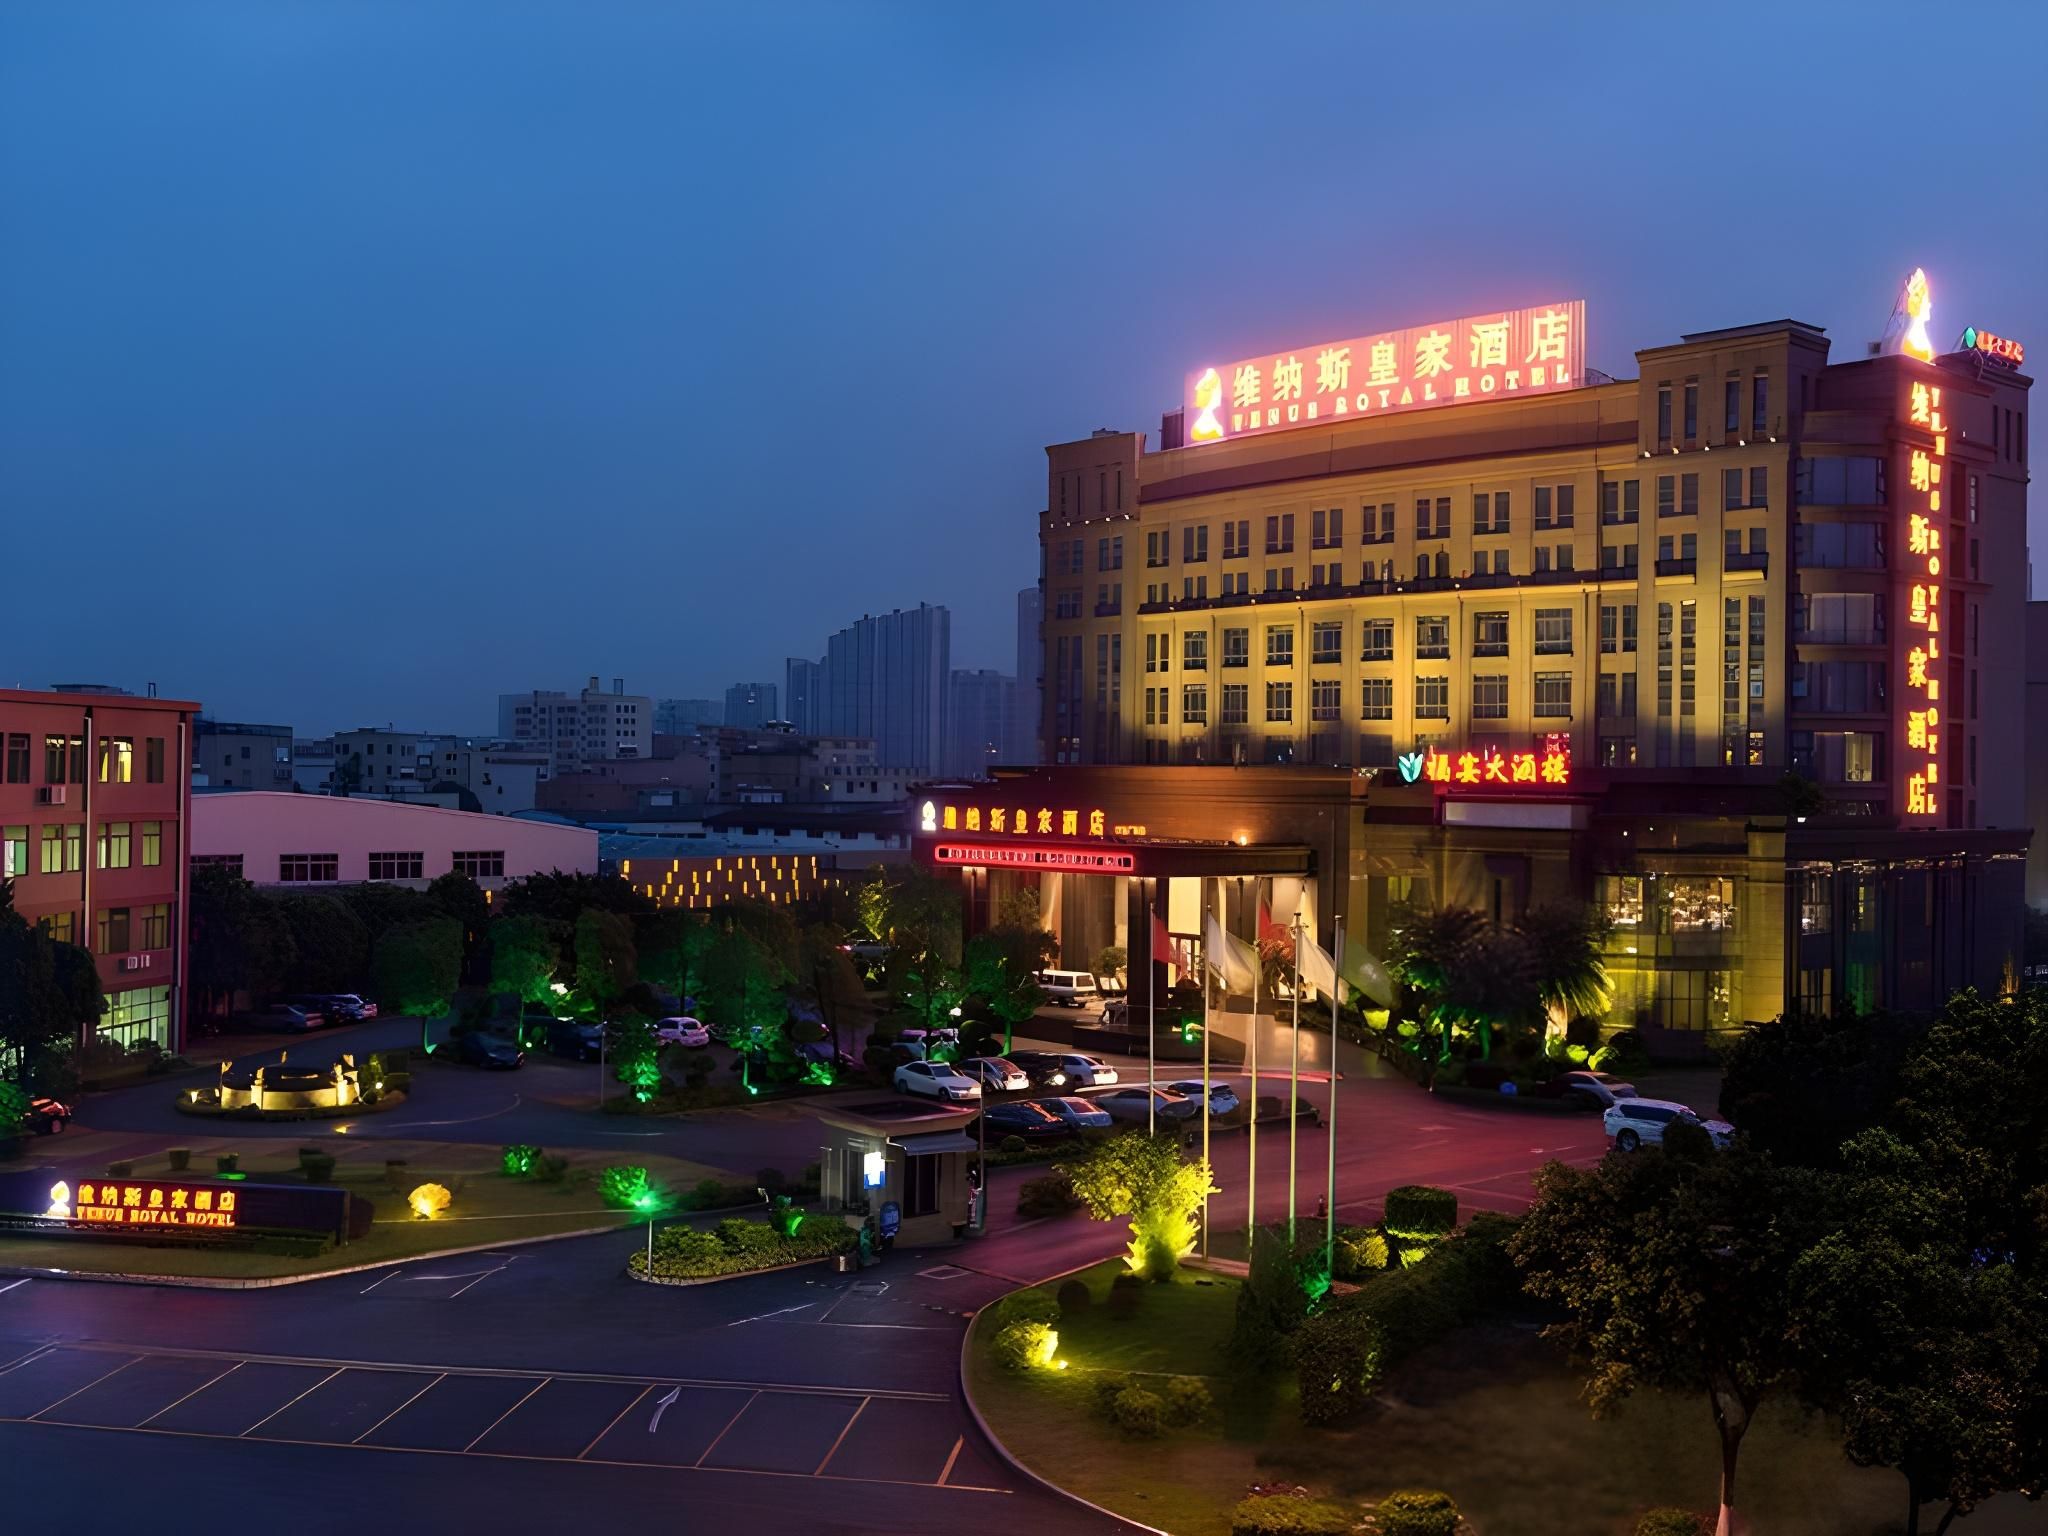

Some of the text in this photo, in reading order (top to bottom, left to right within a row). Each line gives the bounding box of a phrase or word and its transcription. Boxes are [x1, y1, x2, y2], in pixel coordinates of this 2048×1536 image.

[1233, 311, 1569, 407] 维纳斯皇家酒店
[1233, 364, 1569, 432] VENUS ROYAL HOTEL
[1908, 381, 1930, 813] 维纳斯皇家酒店
[130, 1210, 179, 1223] ROYAL
[186, 1212, 235, 1226] HOTEL
